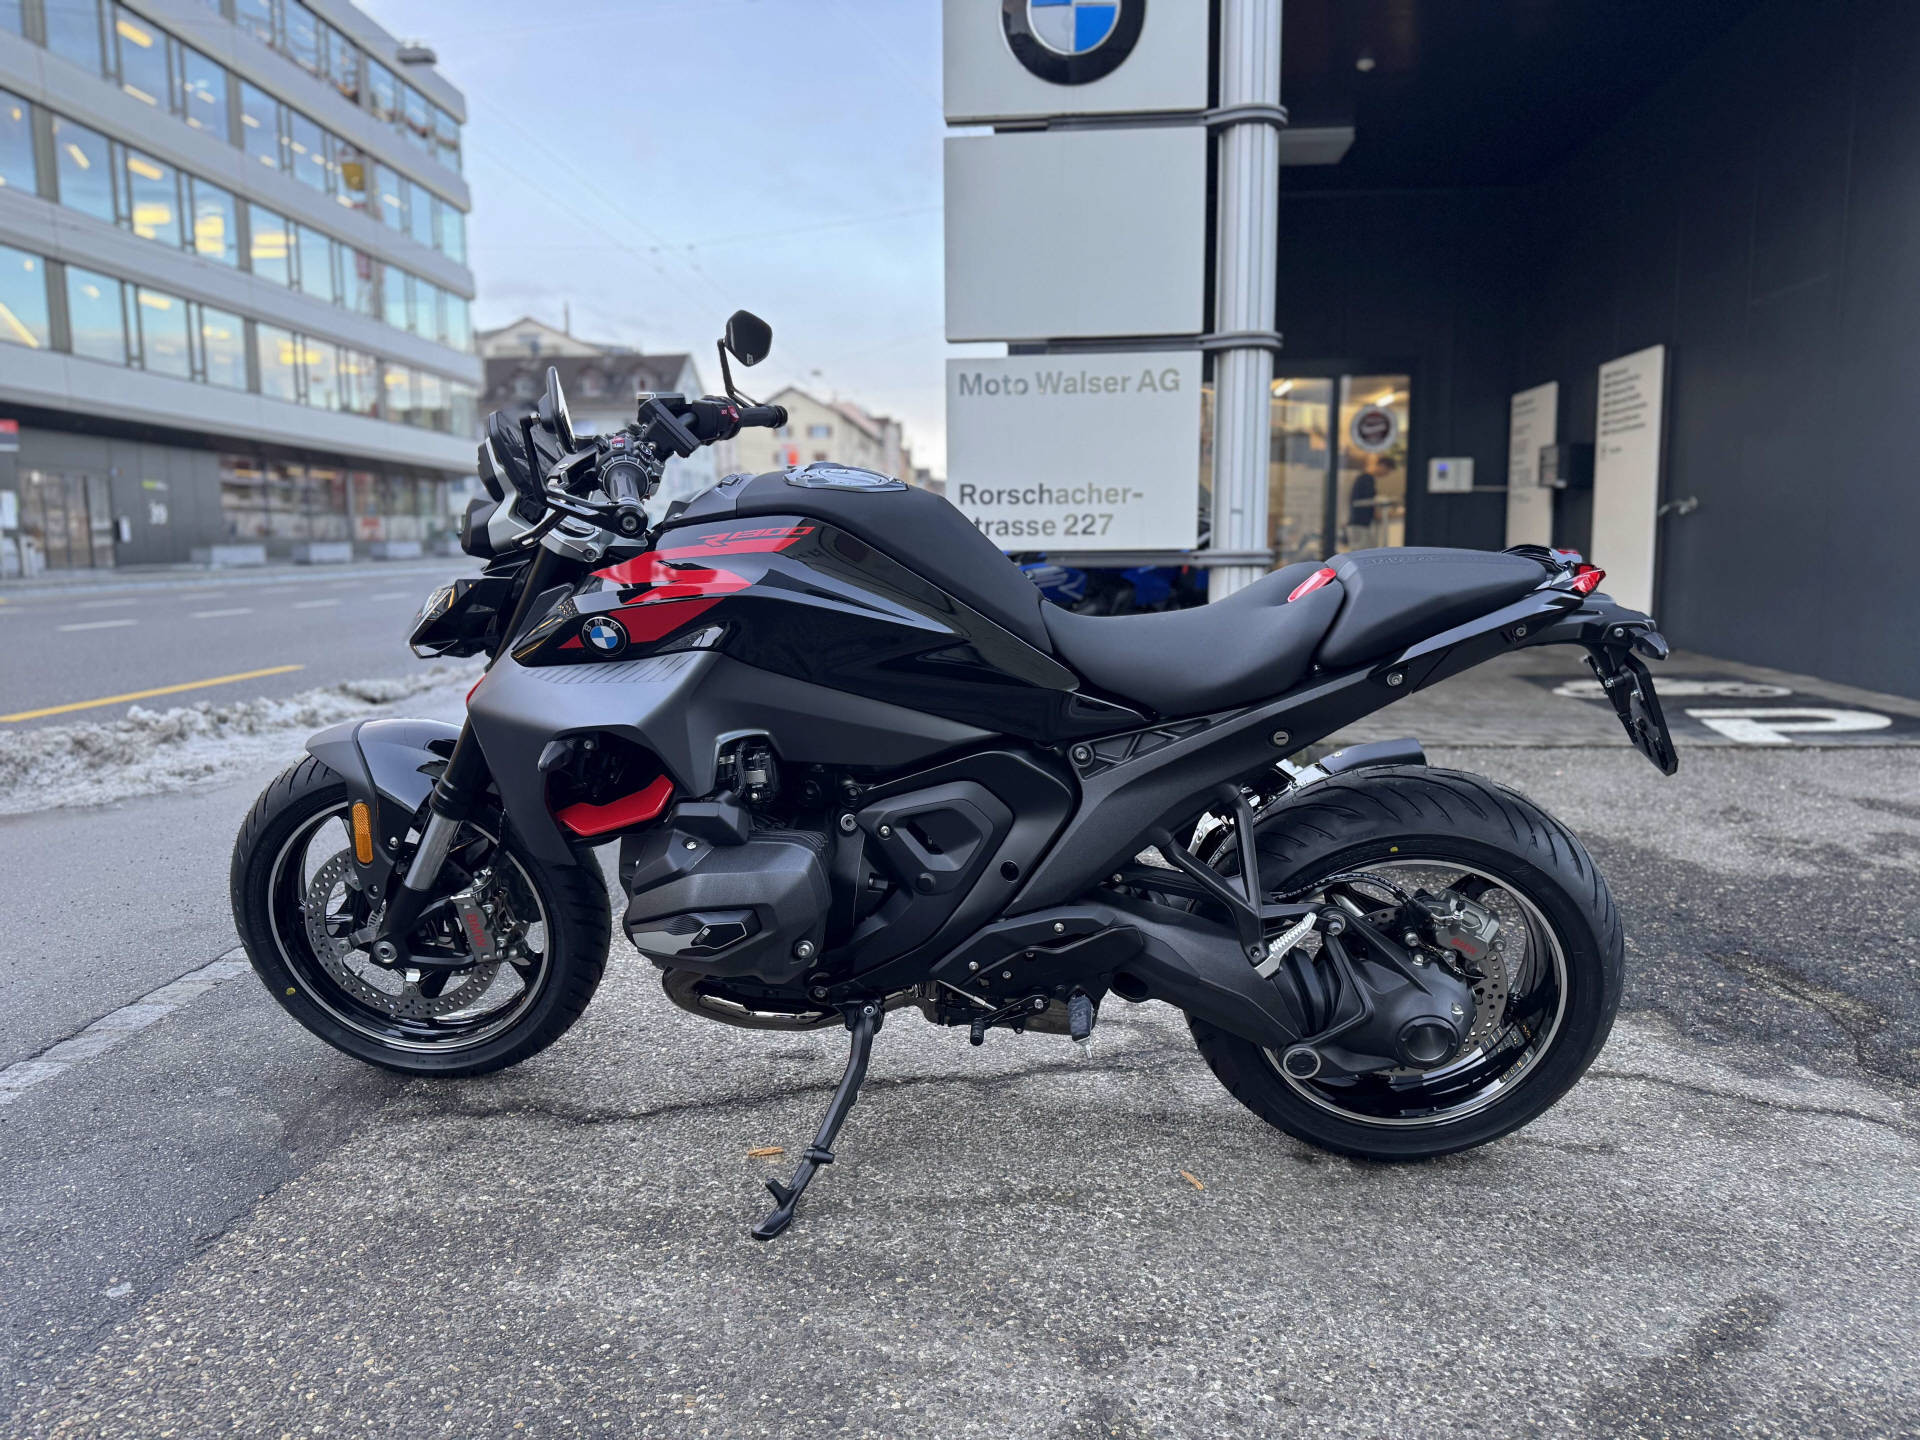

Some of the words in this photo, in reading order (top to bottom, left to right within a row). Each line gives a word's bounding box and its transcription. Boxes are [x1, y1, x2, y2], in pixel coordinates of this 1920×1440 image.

[959, 372, 1029, 396] Moto
[1035, 370, 1132, 394] Walser
[1136, 368, 1181, 393] AG
[959, 482, 1144, 505] Rorschacher-
[974, 516, 1056, 536] trasse
[1063, 513, 1114, 536] 227
[584, 618, 619, 632] BMW
[465, 913, 488, 947] BMW
